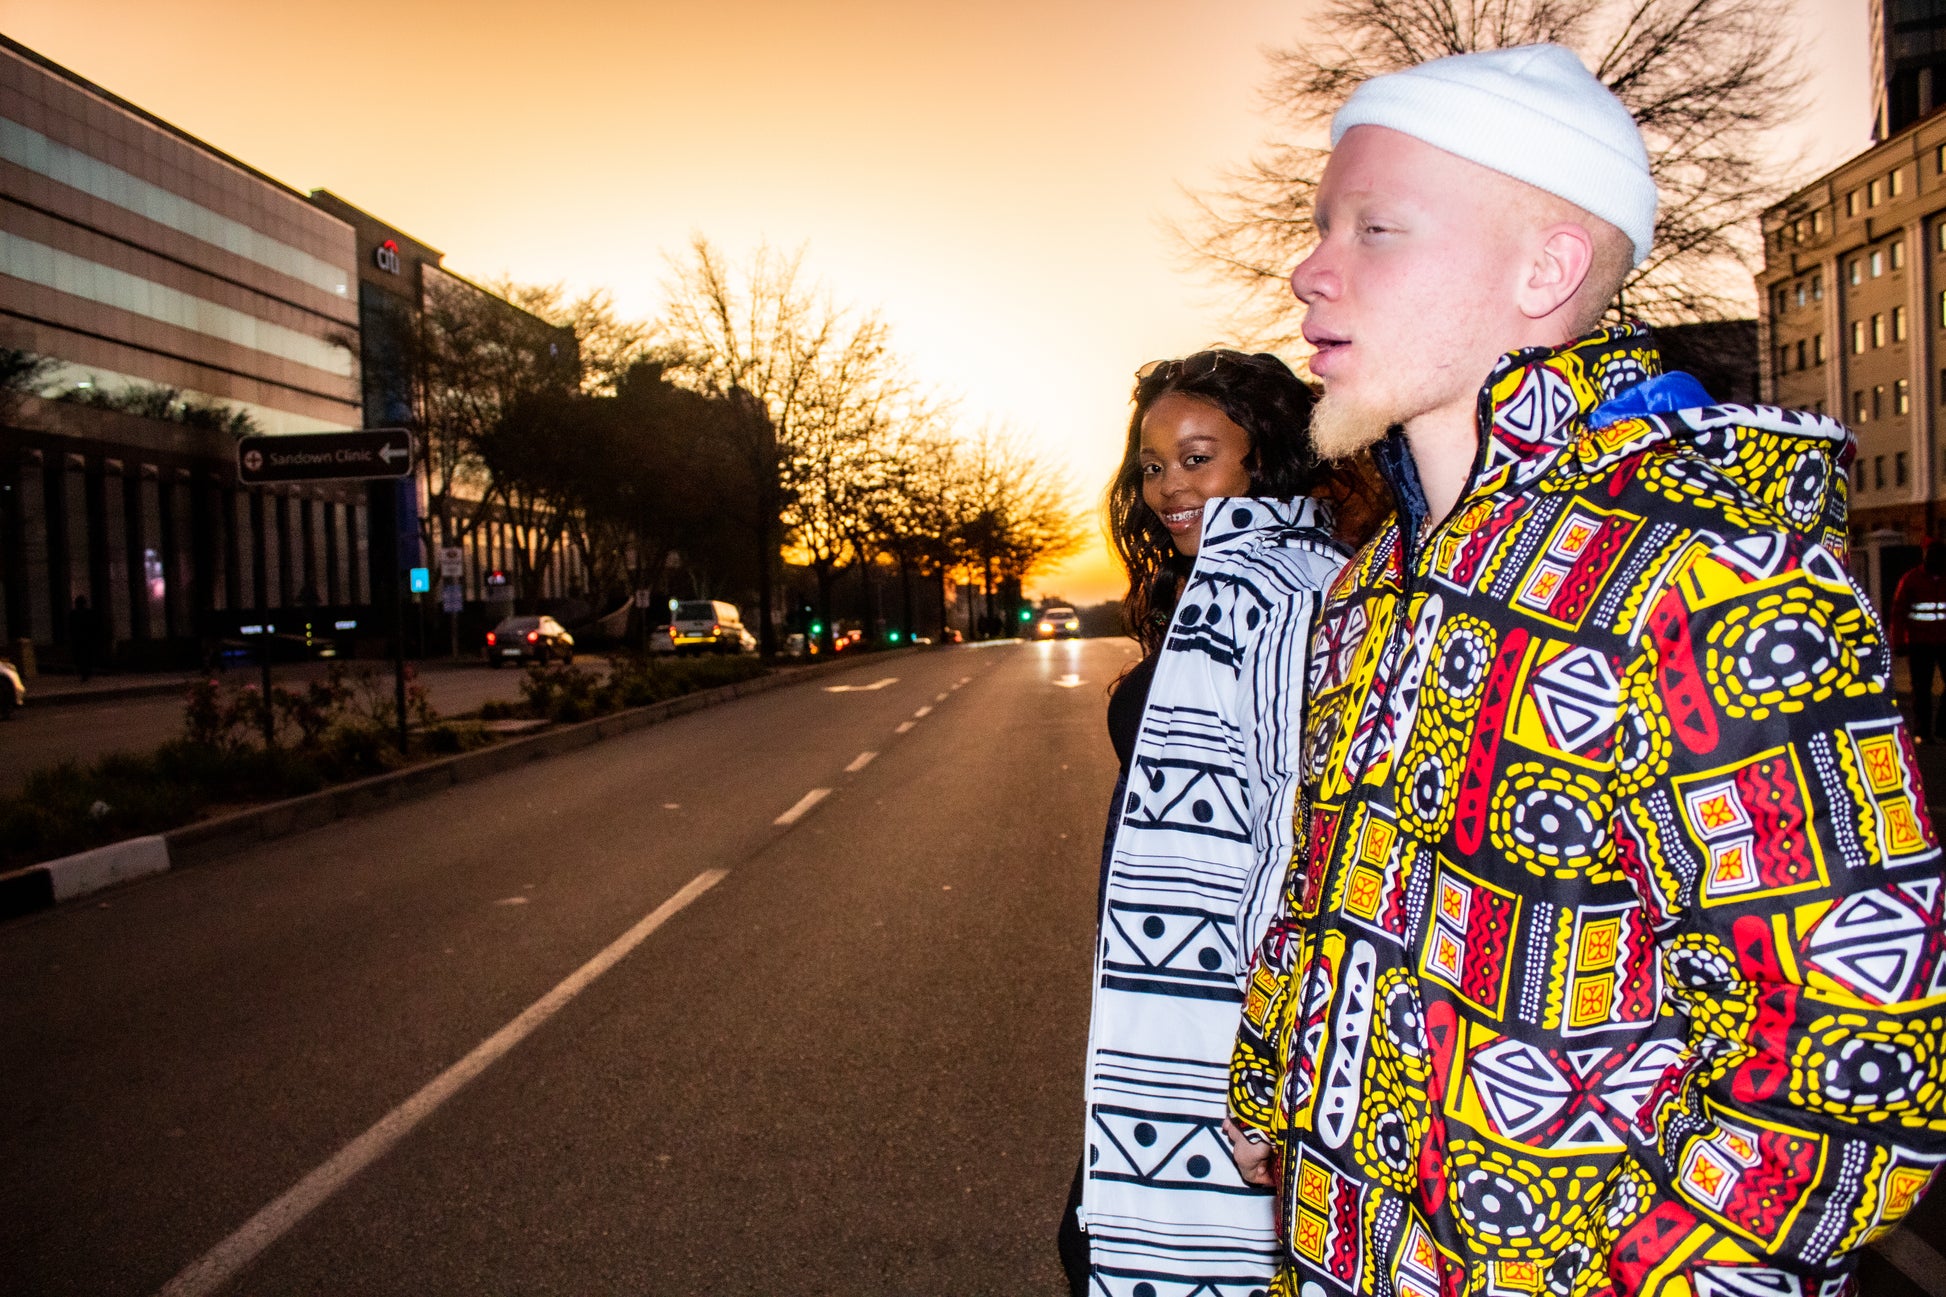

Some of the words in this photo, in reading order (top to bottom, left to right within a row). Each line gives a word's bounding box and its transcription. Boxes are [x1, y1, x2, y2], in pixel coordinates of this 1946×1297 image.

[377, 244, 400, 275] citi
[270, 452, 333, 466] Sandown
[336, 449, 371, 463] Clinic
